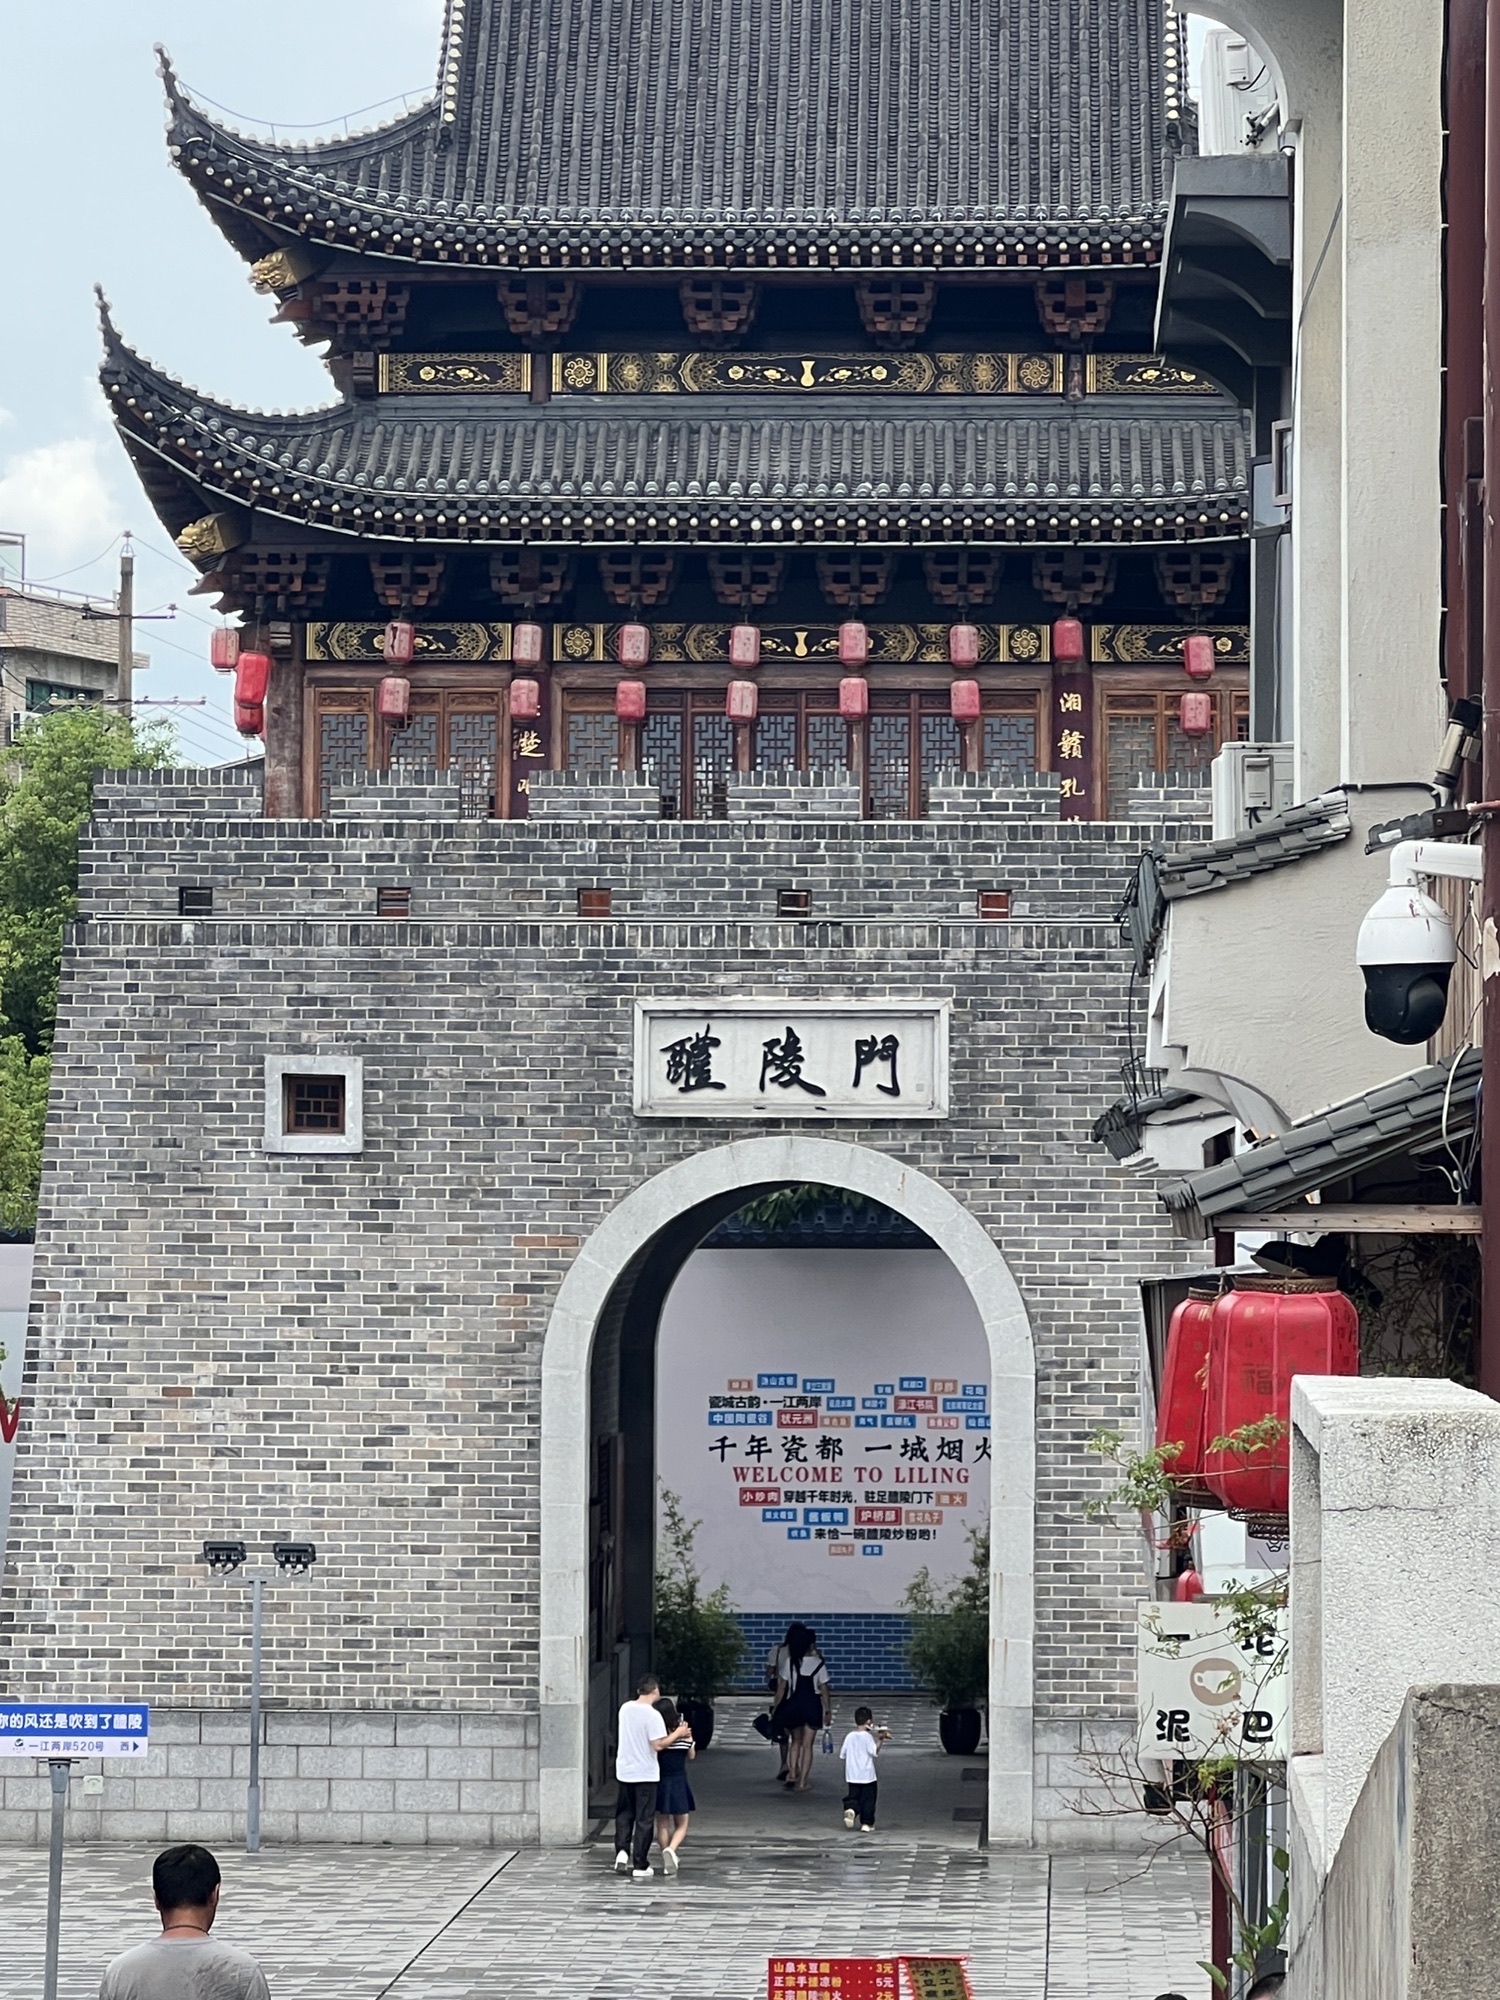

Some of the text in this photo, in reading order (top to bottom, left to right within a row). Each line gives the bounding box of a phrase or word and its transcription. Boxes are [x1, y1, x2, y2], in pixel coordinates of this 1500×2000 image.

[660, 1023, 901, 1097] 醴陵門
[708, 1434, 844, 1463] 千年瓷都
[732, 1466, 970, 1484] WELCOME TO LILING
[28, 1741, 104, 1752] 一江两岸520号
[120, 1741, 130, 1752] 西
[875, 1963, 894, 1974] 3元
[875, 1977, 894, 1988] 5元
